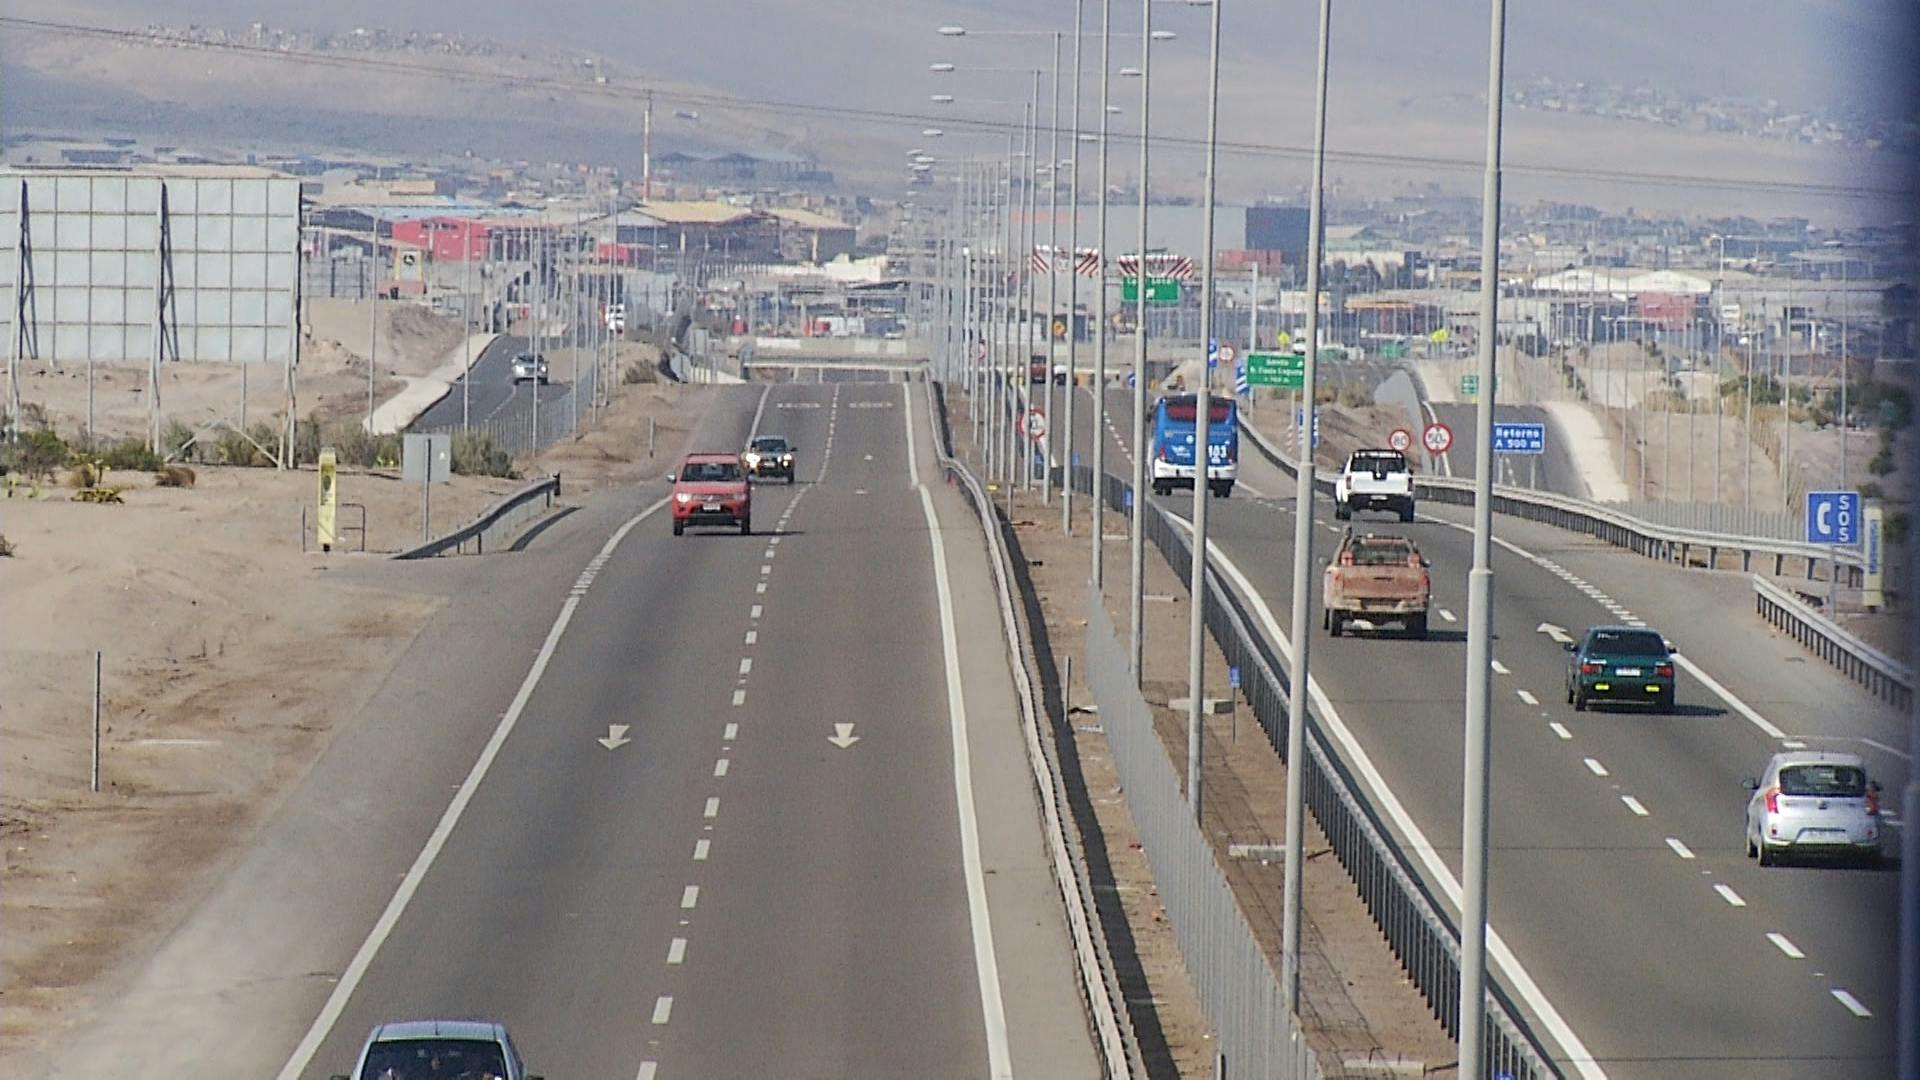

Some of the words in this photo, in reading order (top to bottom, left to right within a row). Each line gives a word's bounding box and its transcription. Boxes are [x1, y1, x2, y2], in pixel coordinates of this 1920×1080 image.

[1495, 428, 1539, 438] Retorno
[1394, 436, 1407, 446] 80
[1495, 439, 1502, 448] A
[1508, 439, 1527, 448] 500
[1838, 495, 1850, 542] SOS
